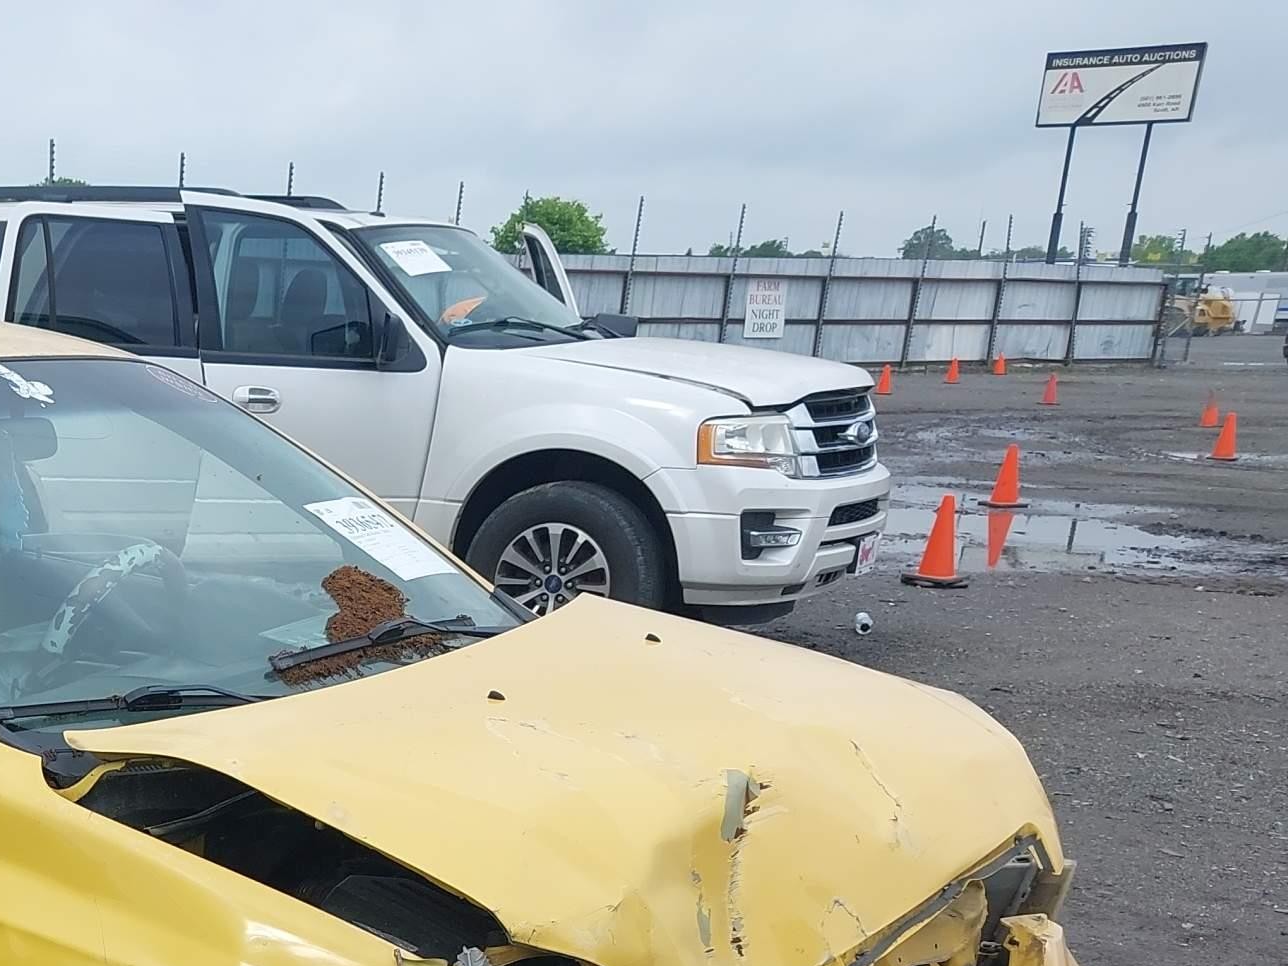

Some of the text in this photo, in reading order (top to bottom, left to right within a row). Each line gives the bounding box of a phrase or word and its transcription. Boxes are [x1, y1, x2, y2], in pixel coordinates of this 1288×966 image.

[1052, 49, 1197, 67] INSURANCE AUTO AUCTIONS
[756, 280, 780, 291] FARM
[749, 294, 782, 305] BUREAU
[751, 309, 780, 320] NIGHT
[752, 322, 778, 333] DROP
